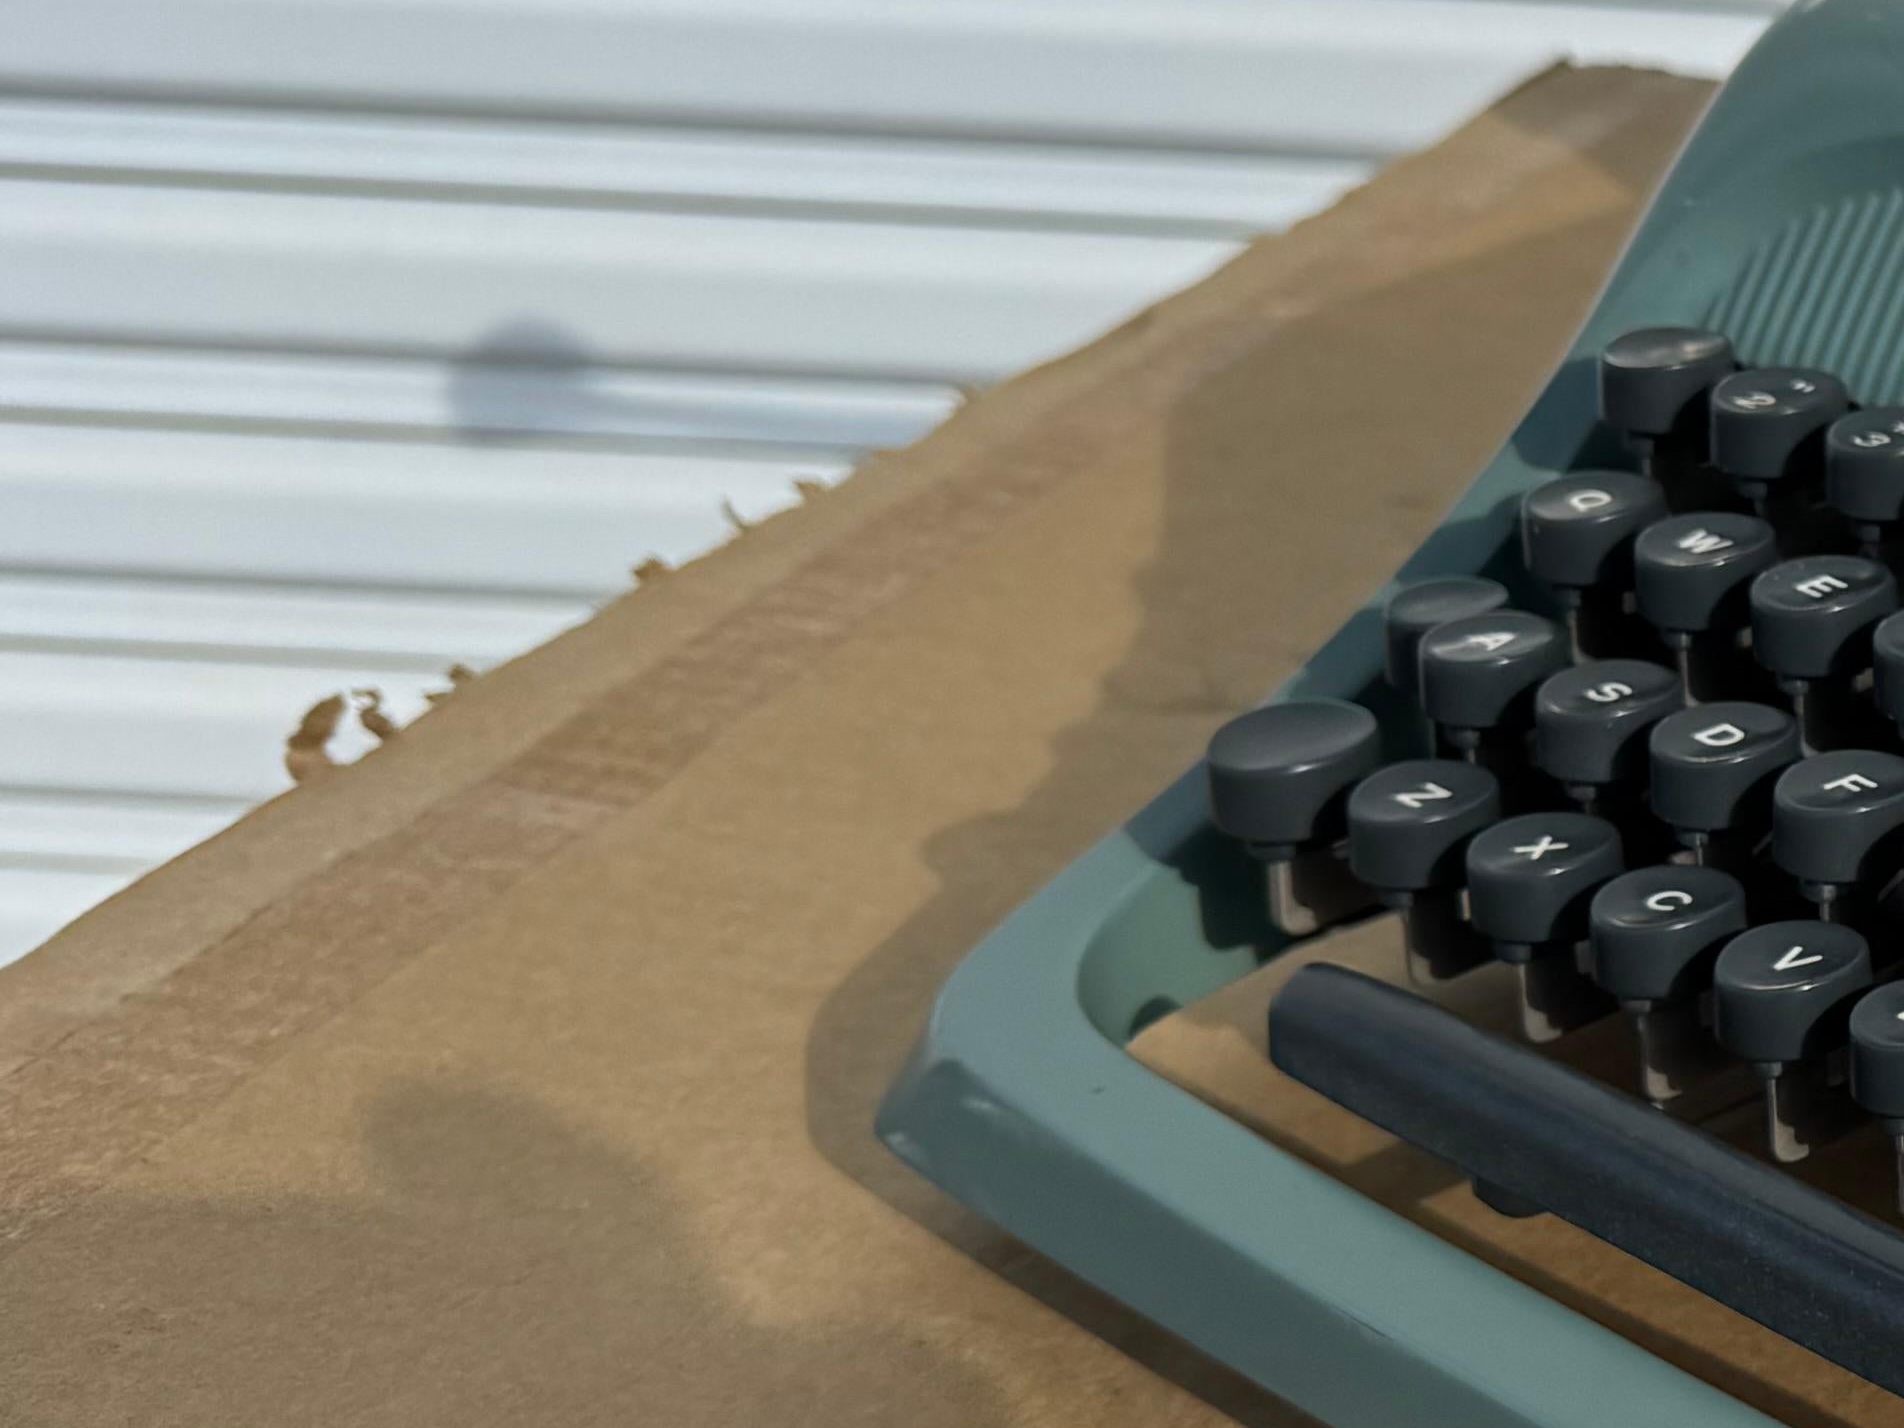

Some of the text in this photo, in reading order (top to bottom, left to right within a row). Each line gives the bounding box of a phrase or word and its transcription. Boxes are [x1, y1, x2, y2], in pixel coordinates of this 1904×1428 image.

[1733, 392, 1777, 409] 2
[1852, 433, 1892, 447] 3
[1568, 489, 1613, 512] Q
[1678, 530, 1733, 554] W
[1794, 575, 1849, 598] E
[1466, 631, 1517, 652] A
[1585, 682, 1633, 702] S
[1692, 723, 1746, 746] D
[1822, 773, 1879, 792] F
[1394, 782, 1453, 808] Z
[1512, 835, 1569, 860] X
[1645, 890, 1694, 911] C
[1772, 946, 1824, 971] V
